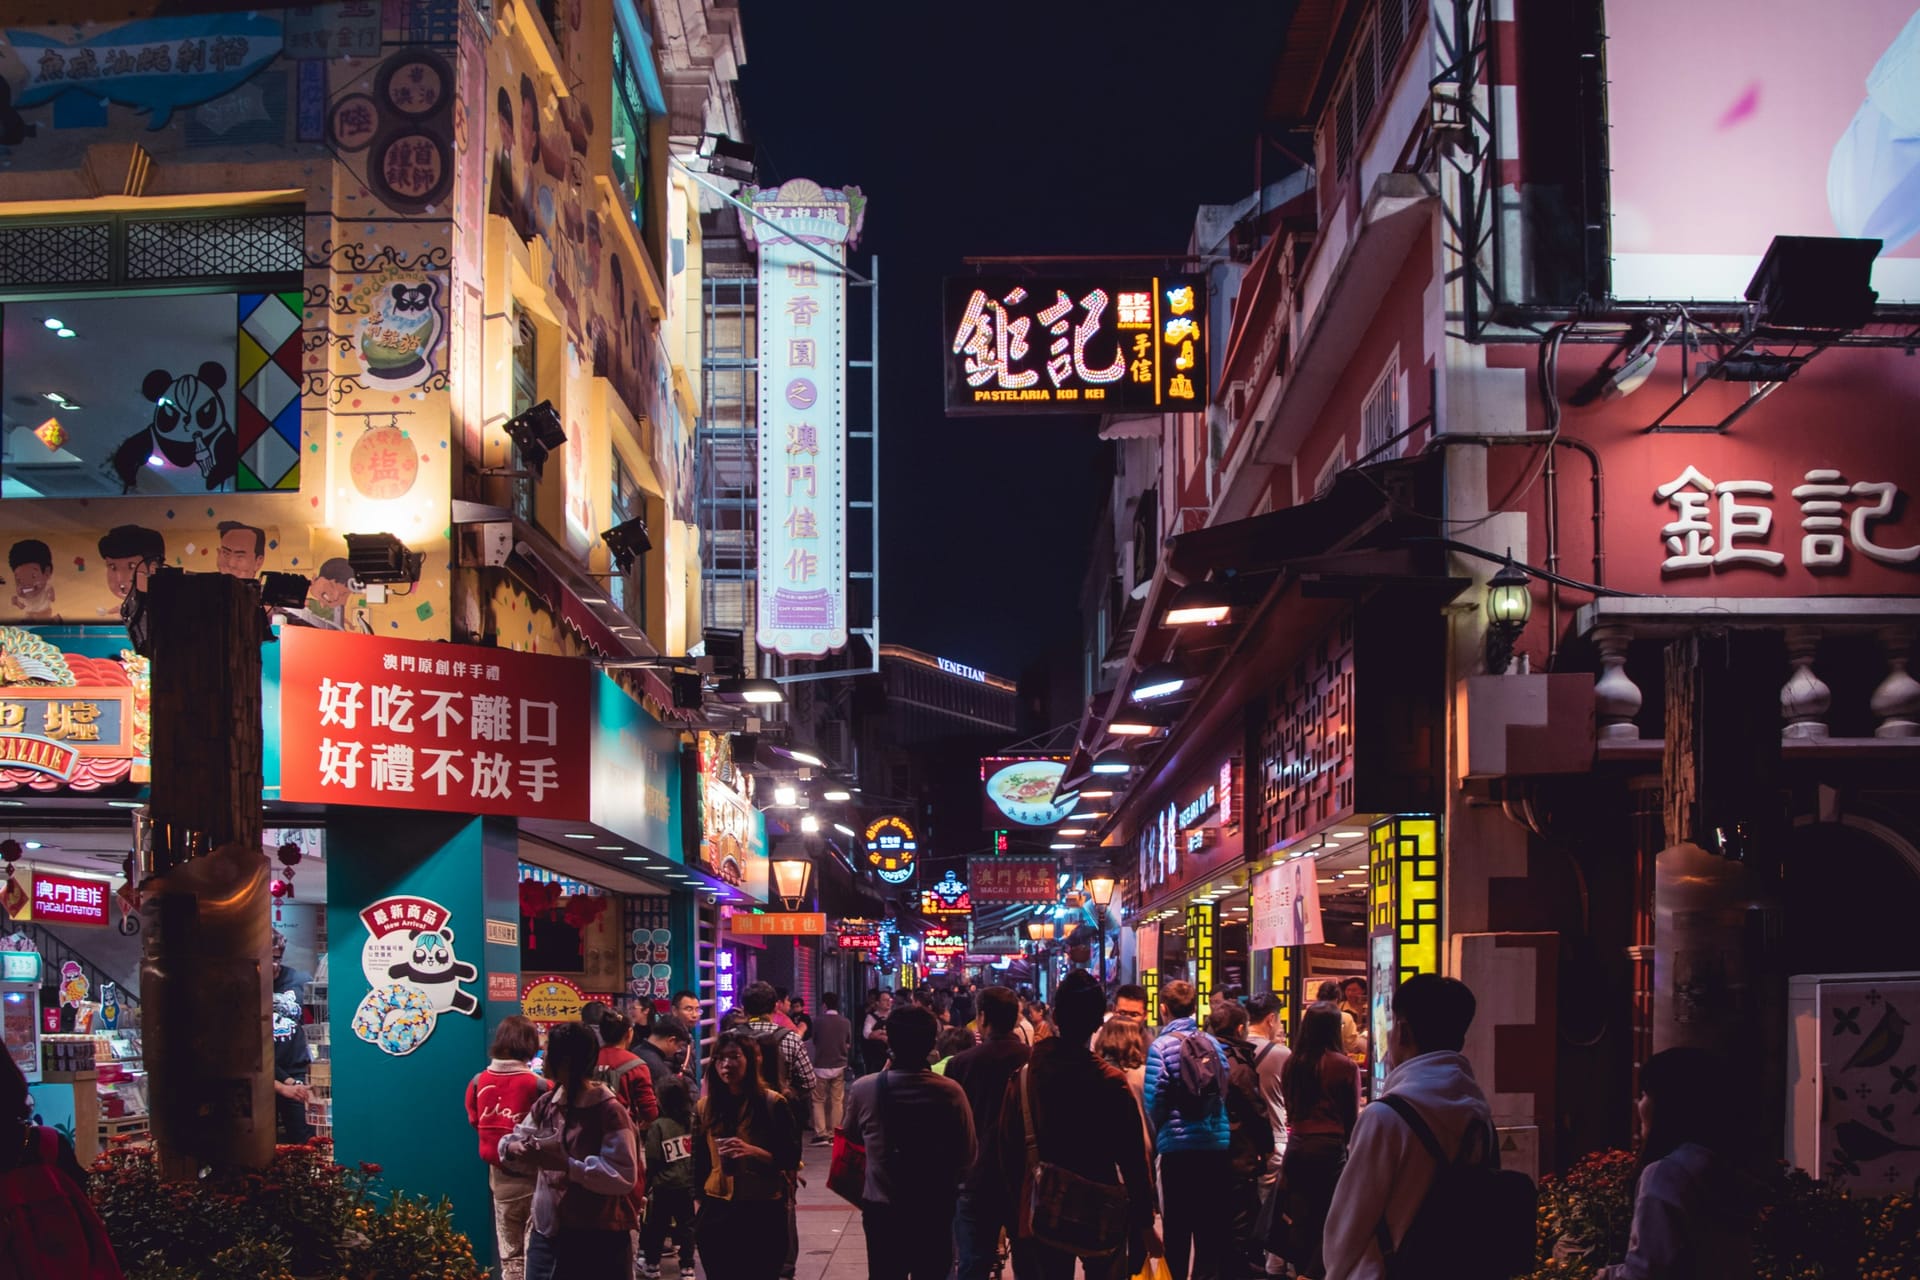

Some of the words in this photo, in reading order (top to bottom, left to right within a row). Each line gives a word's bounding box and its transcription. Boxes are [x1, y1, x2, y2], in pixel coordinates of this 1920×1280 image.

[1130, 333, 1152, 383] 手信
[974, 390, 1050, 401] PASTELARIA
[1056, 389, 1078, 400] KOI
[1084, 388, 1105, 399] KEI
[1655, 465, 1920, 571] 鉅記
[383, 654, 500, 681] 澳門原創伴手禮
[937, 656, 985, 682] VENETIAN
[318, 677, 558, 746] 好吃不離口
[318, 738, 559, 802] 好禮不放手
[36, 880, 102, 906] 澳門佳作
[373, 904, 438, 926] 最新商品
